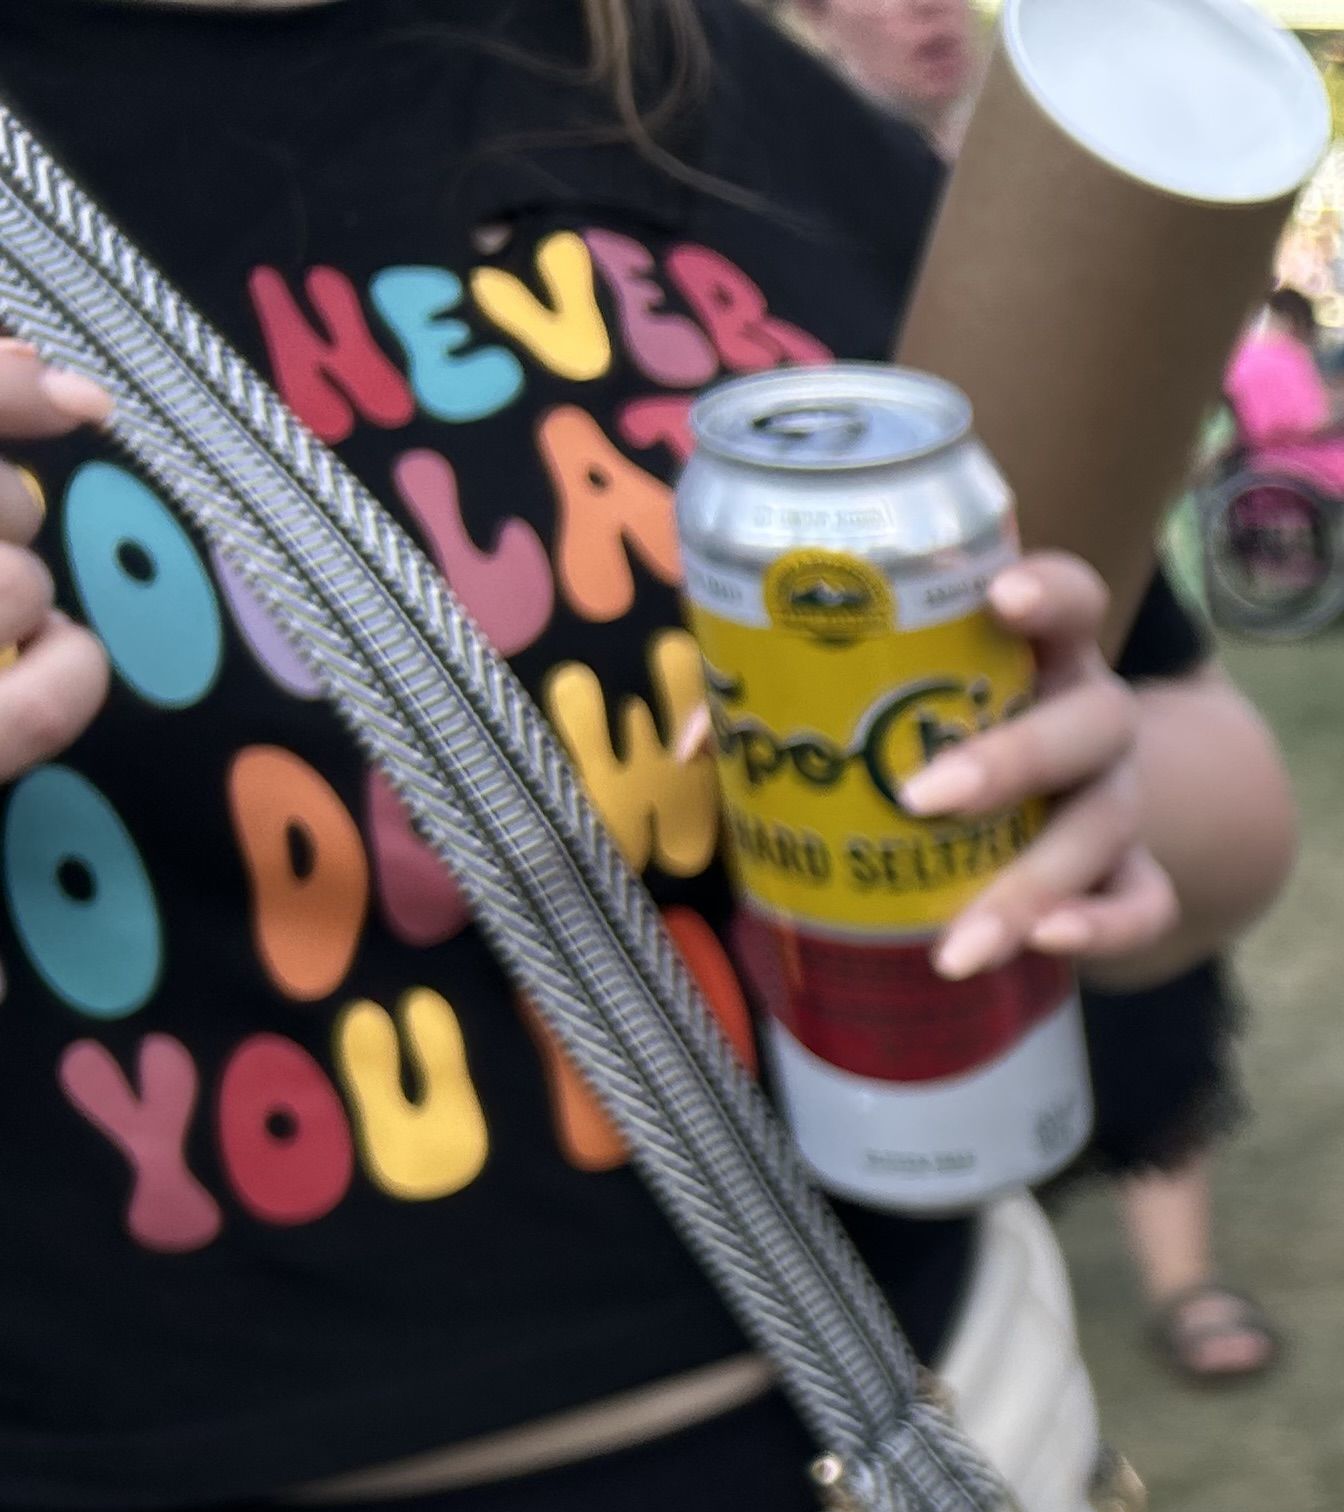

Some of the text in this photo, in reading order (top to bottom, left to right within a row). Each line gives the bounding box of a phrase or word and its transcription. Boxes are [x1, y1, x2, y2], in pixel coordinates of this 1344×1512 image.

[249, 228, 834, 445] NEVER
[843, 811, 1030, 891] SELTZE
[56, 987, 489, 1254] YOU
